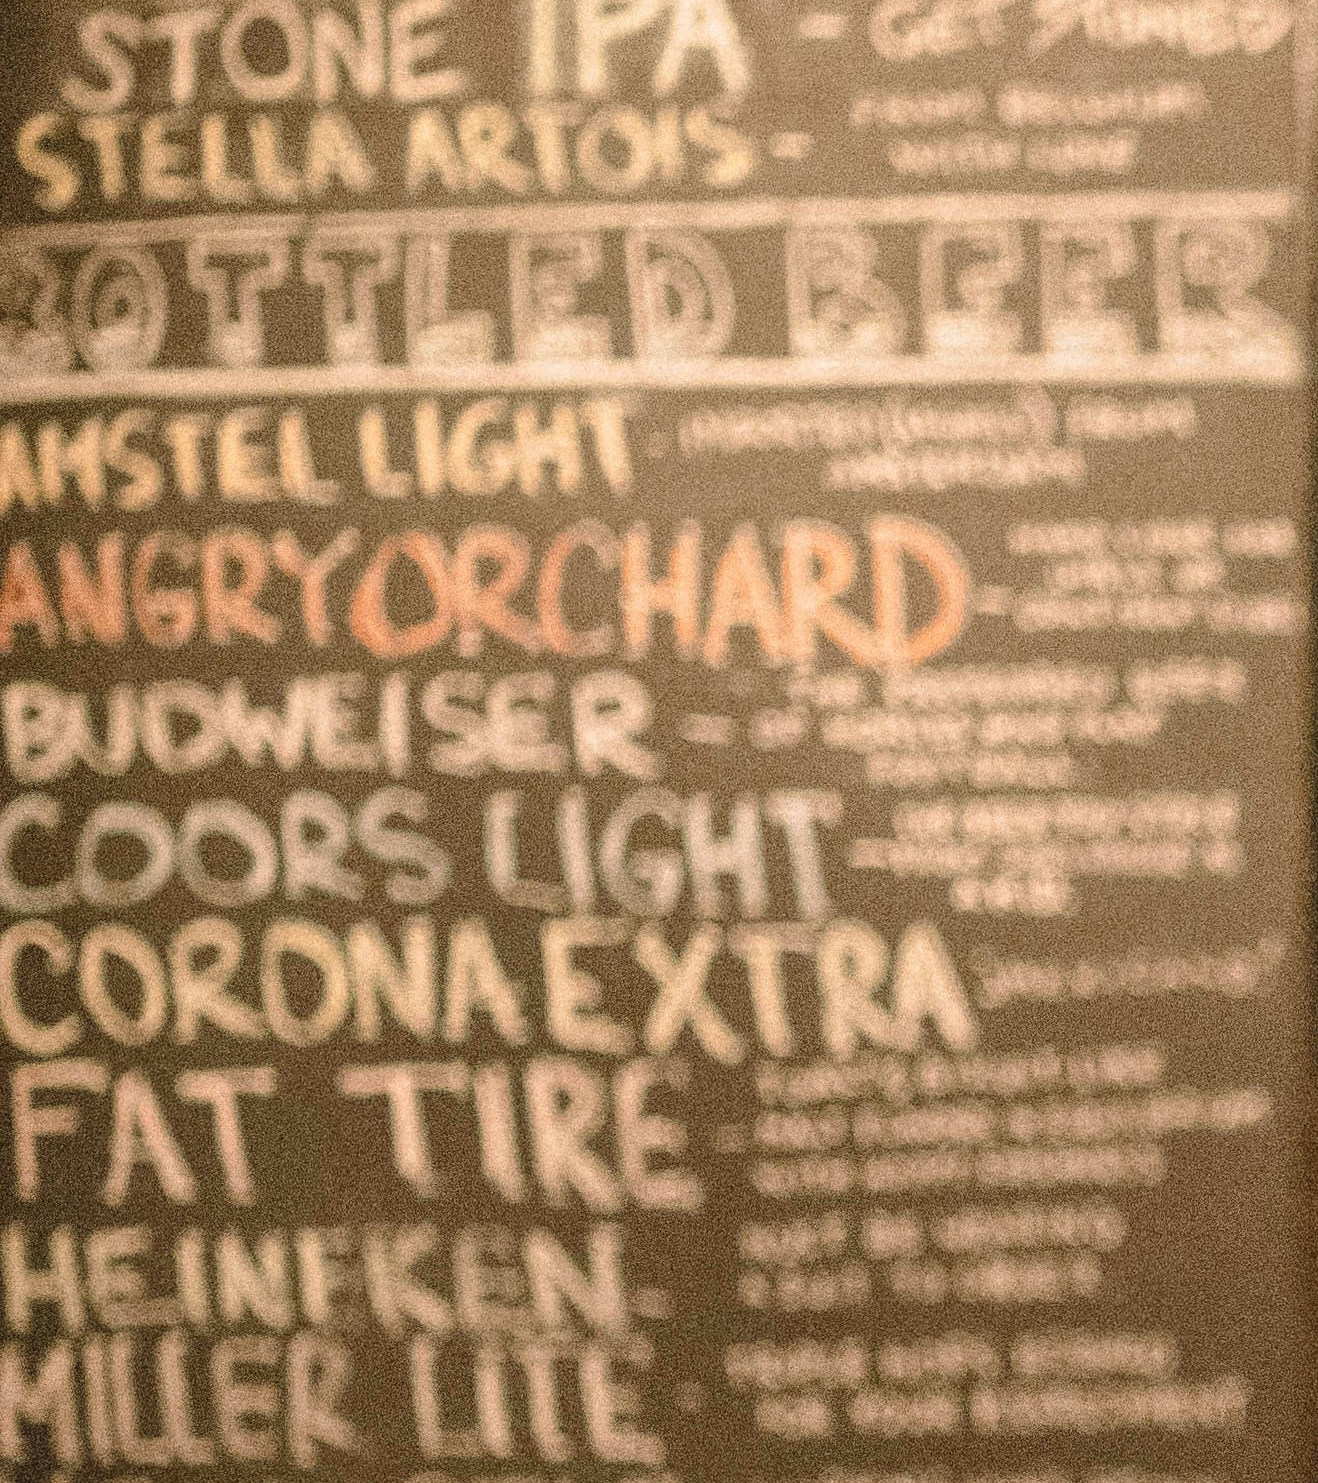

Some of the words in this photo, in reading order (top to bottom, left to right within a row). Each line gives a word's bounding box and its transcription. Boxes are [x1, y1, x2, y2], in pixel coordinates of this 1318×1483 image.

[16, 111, 375, 214] STELLA
[403, 101, 754, 195] ARTOIS
[785, 217, 1294, 362] BEER
[358, 398, 636, 501] LIGHT
[3, 671, 663, 784] BUDWEISER
[0, 787, 452, 914] COORS
[485, 785, 844, 919] LIGHT
[3, 918, 530, 1055] CORONA
[540, 915, 979, 1065] EXTRA
[9, 1055, 279, 1209] FAT
[338, 1055, 701, 1214] TIRE
[0, 1328, 357, 1468] MILLER
[409, 1329, 668, 1465] LITE
